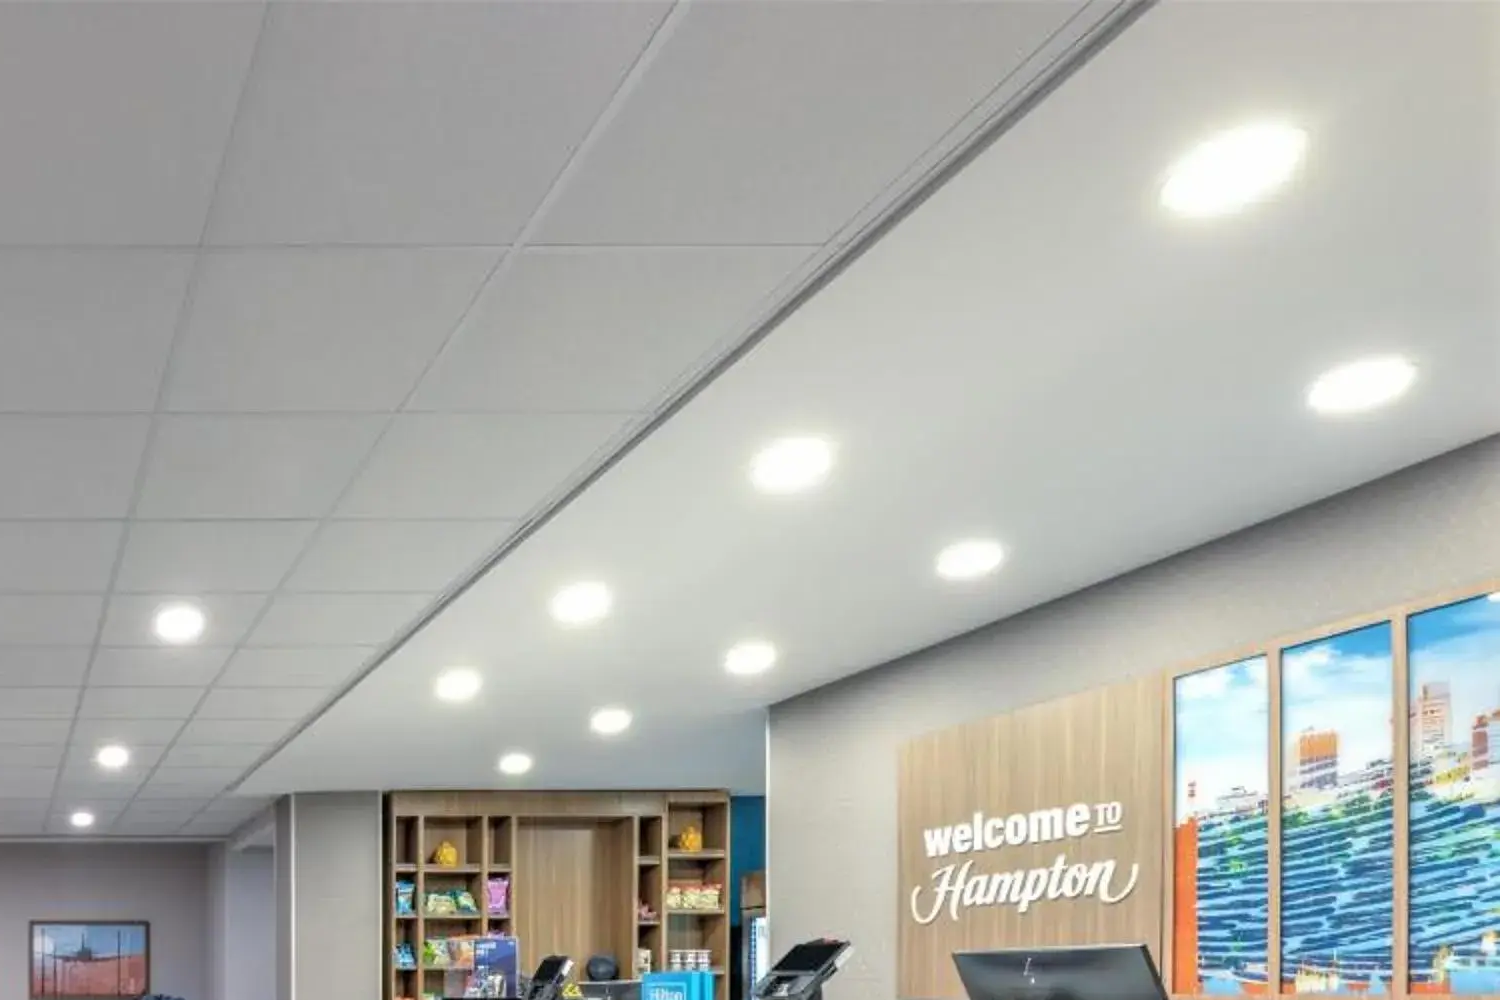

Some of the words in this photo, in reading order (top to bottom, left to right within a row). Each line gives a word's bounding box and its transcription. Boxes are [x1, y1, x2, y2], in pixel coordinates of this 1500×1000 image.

[924, 803, 1091, 857] welcome
[1094, 802, 1123, 827] TO
[911, 853, 1139, 924] Hampton
